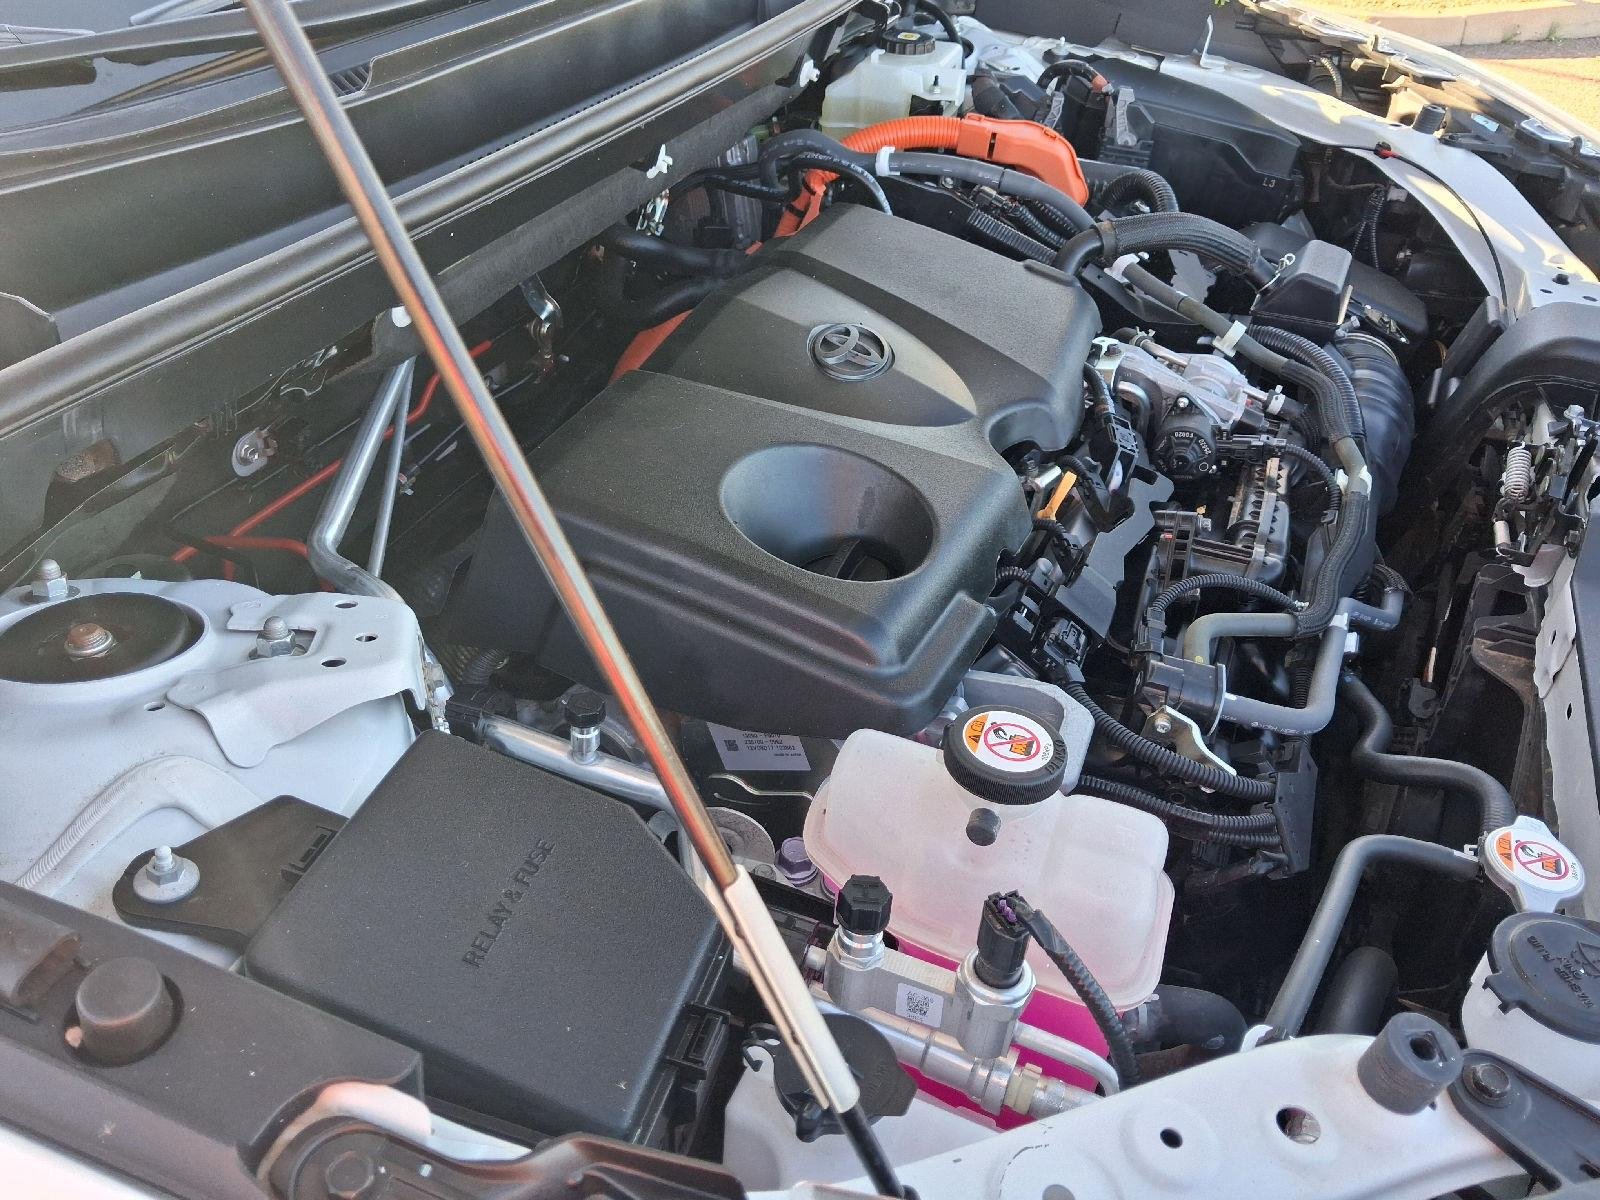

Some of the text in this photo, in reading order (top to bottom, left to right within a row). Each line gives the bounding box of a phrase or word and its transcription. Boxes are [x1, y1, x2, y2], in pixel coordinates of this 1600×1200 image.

[462, 838, 556, 968] RELAY & FUSE
